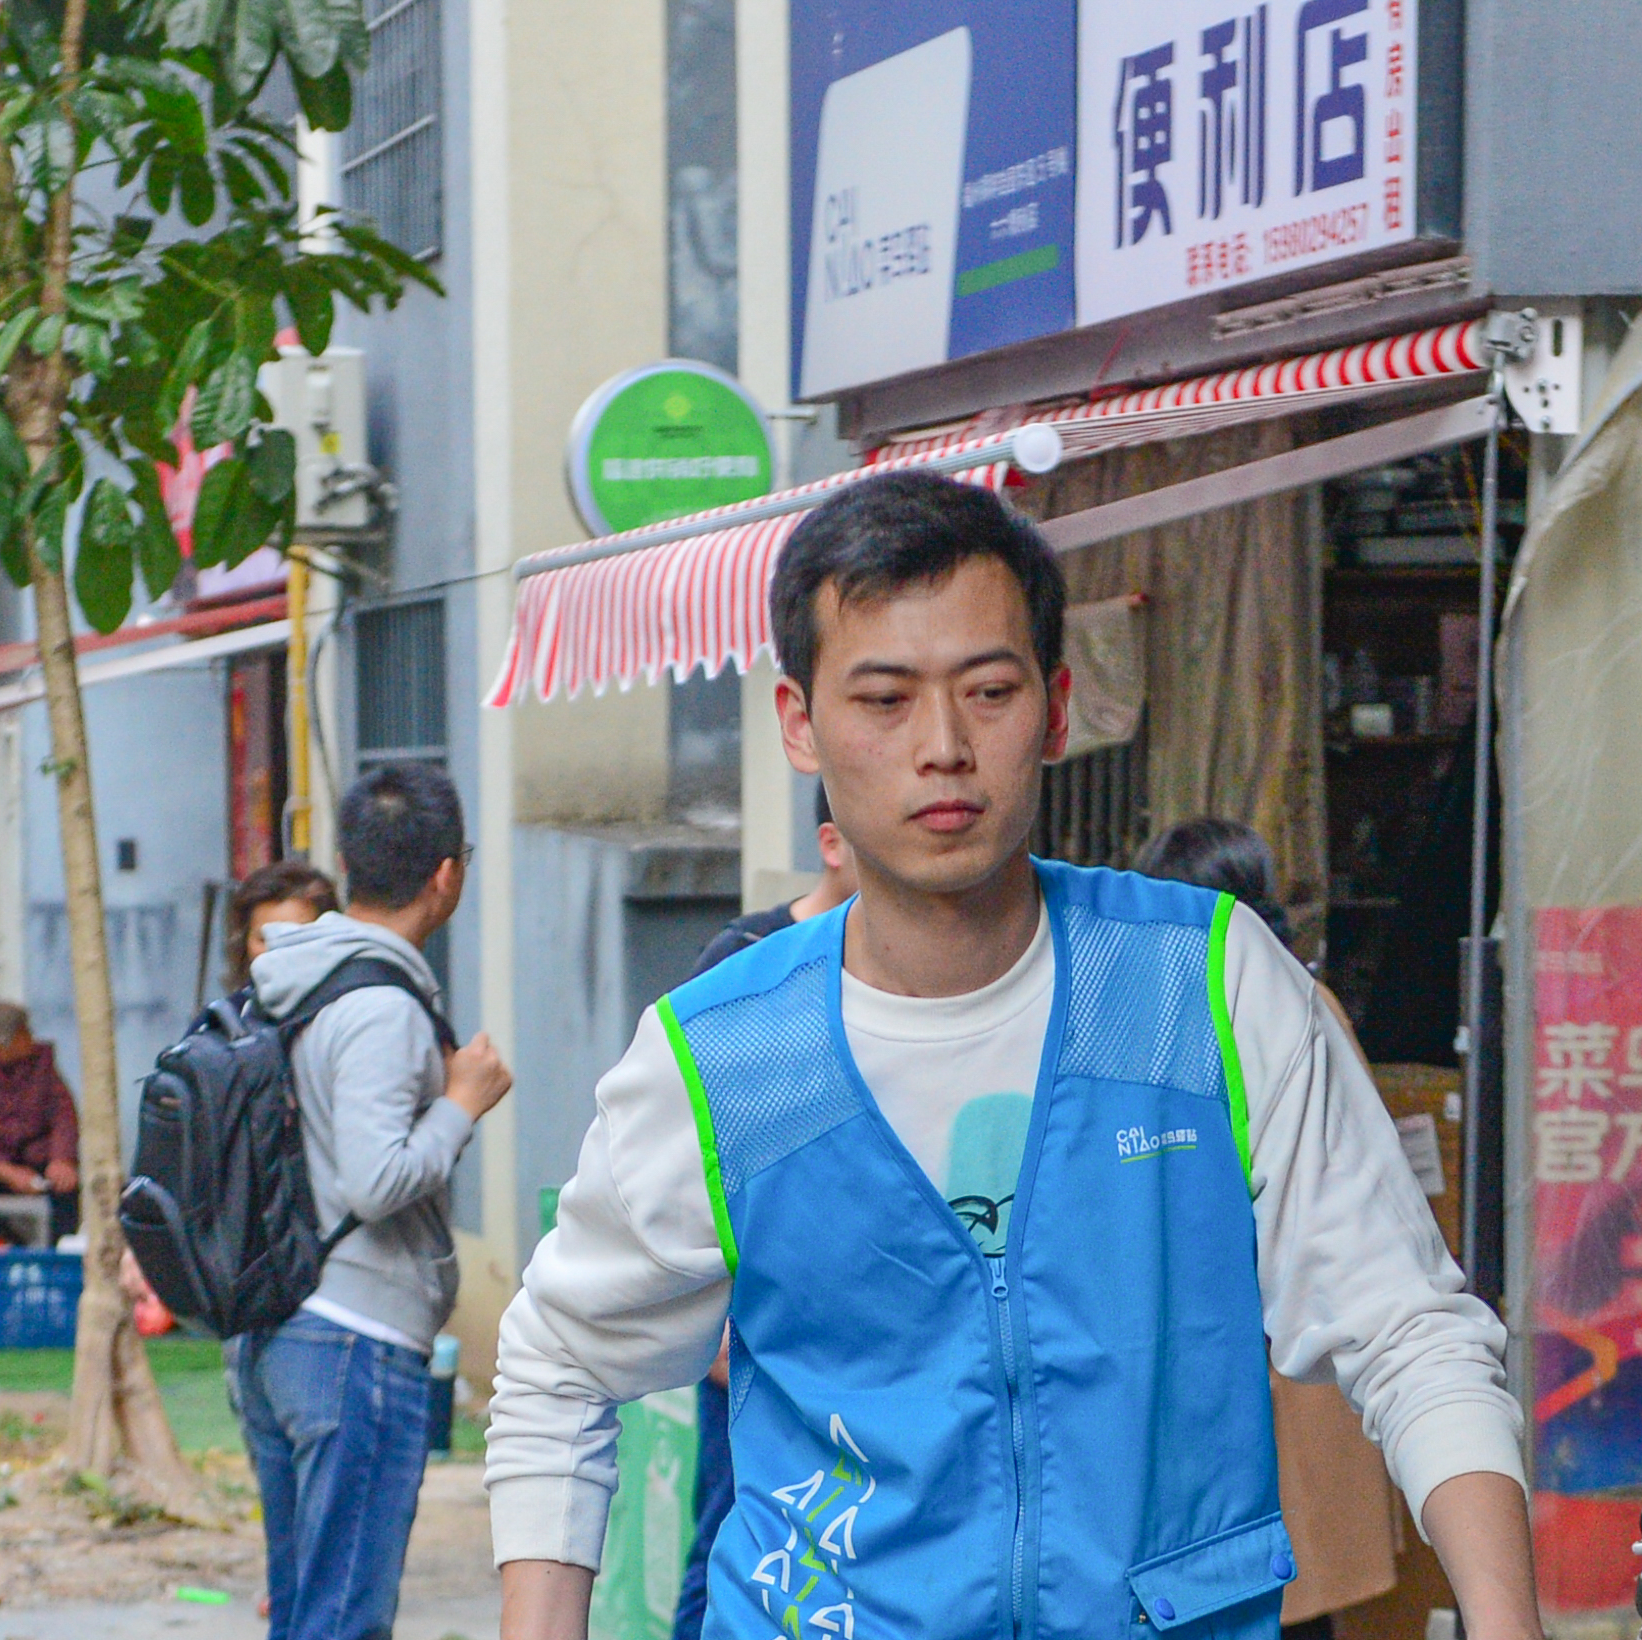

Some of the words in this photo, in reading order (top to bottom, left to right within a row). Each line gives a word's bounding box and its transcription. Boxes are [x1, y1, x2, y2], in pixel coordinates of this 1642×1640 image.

[1114, 0, 1369, 249] 便利店
[1116, 1125, 1146, 1143] CAI
